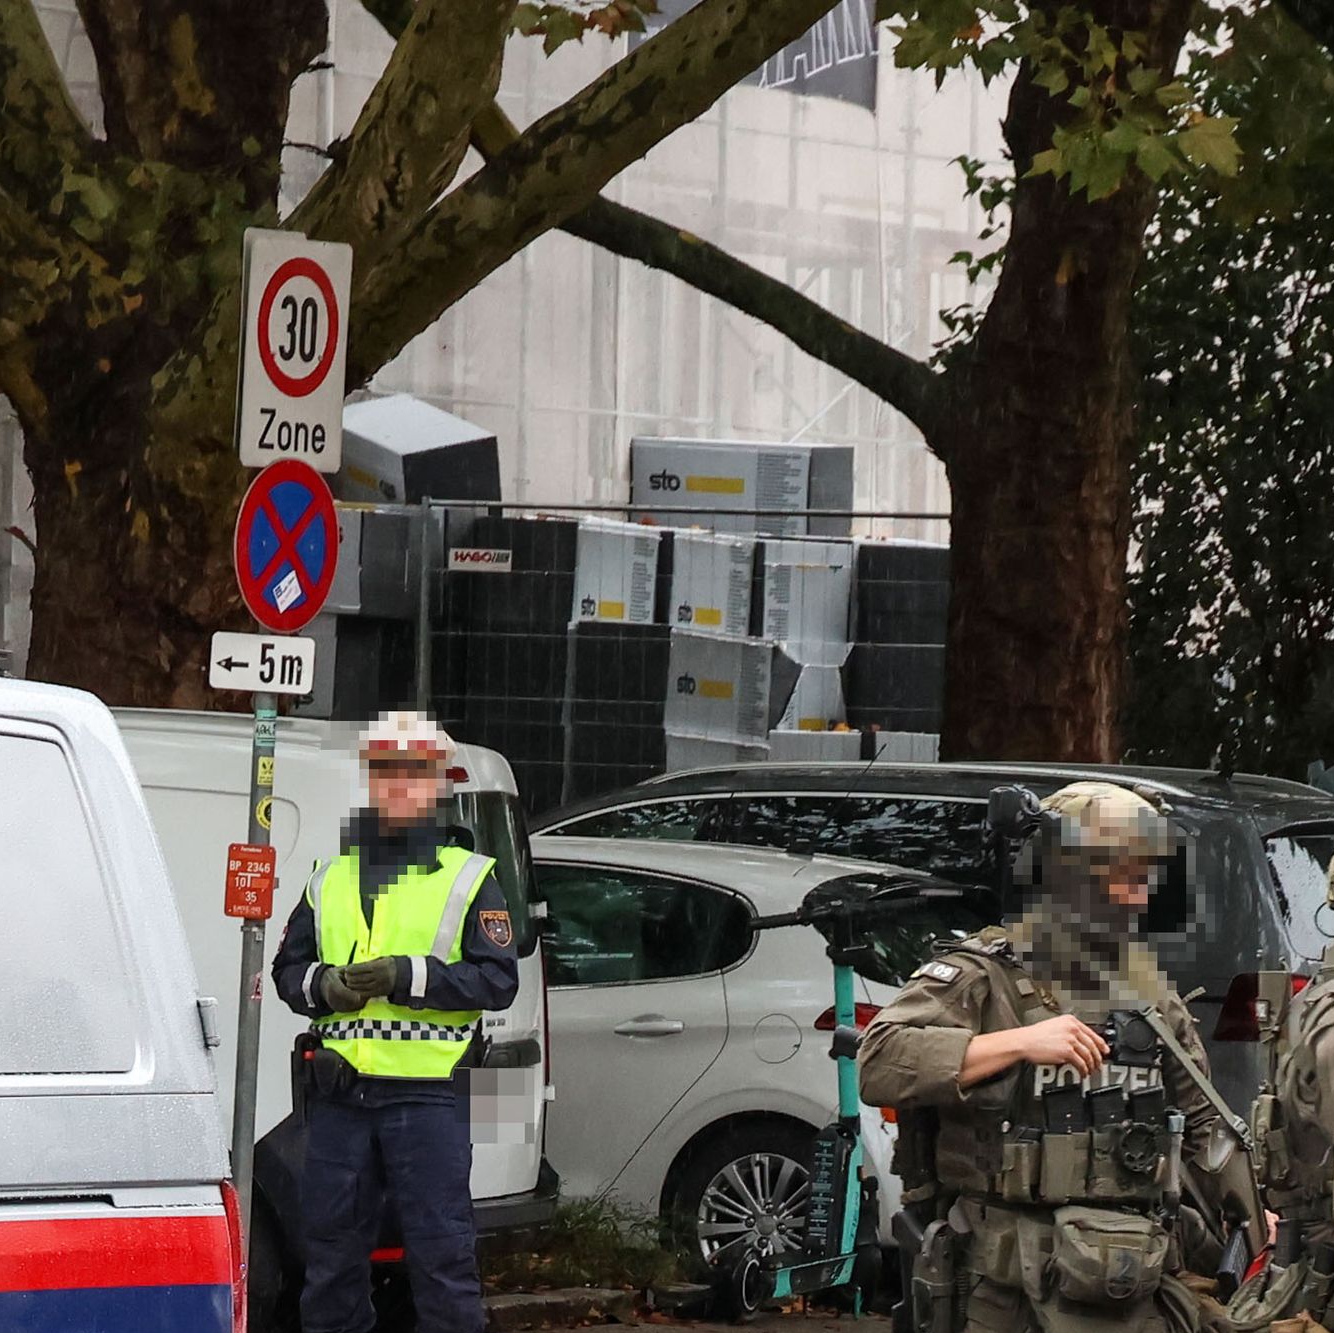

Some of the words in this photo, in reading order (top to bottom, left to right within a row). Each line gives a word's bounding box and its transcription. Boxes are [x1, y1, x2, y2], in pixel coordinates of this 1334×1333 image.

[279, 295, 318, 363] 30
[258, 407, 325, 453] Zone
[649, 469, 681, 492] sto
[580, 594, 597, 617] sto
[677, 601, 693, 624] sto
[677, 672, 696, 696] sto
[229, 860, 242, 871] BP
[247, 862, 271, 874] 2346
[245, 891, 258, 903] 35
